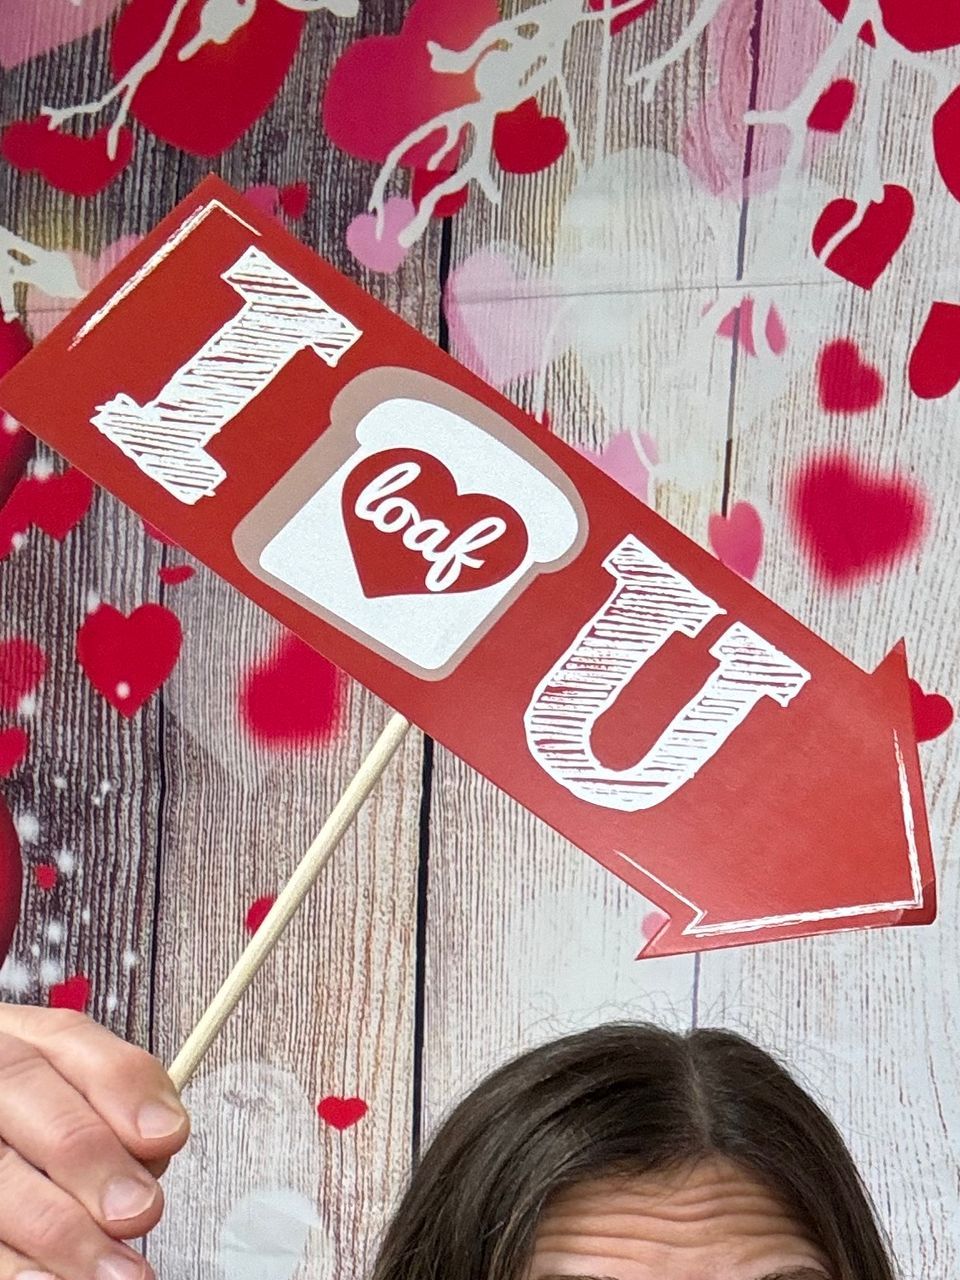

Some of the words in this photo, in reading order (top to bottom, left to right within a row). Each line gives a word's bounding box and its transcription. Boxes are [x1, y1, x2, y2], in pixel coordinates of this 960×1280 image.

[91, 246, 362, 503] I
[353, 462, 505, 591] loaf
[523, 535, 810, 811] U
